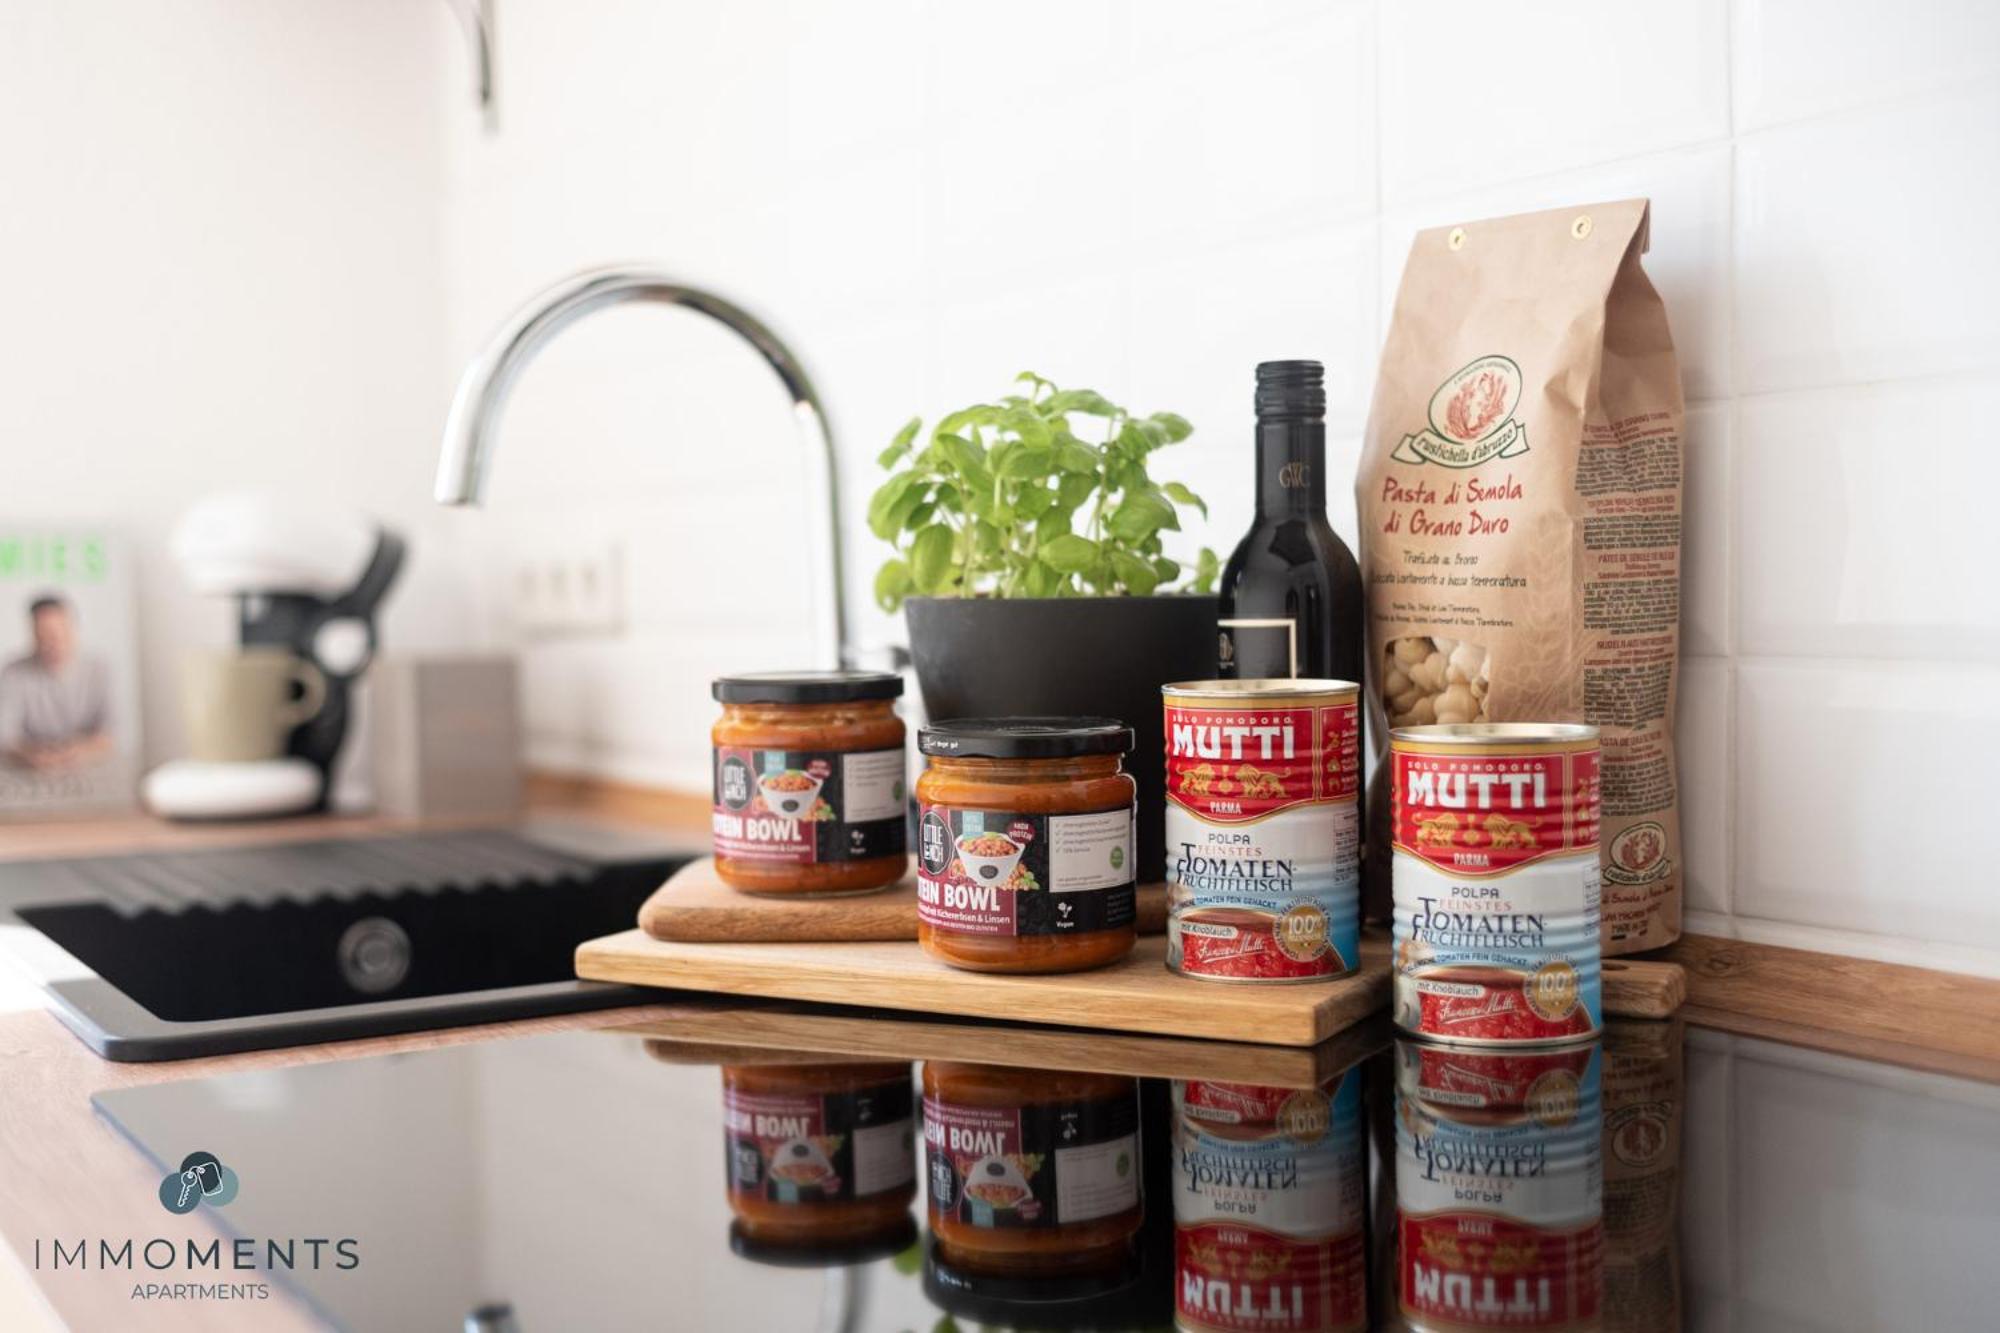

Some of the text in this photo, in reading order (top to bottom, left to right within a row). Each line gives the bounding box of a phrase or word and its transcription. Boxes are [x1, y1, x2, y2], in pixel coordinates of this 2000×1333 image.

[1382, 473, 1523, 504] Pasta di Semola
[1384, 508, 1509, 536] di Grano Duro
[1172, 723, 1295, 760] MUTTI
[1407, 761, 1439, 771] SOLO
[1407, 770, 1546, 809] MUTTI
[1209, 801, 1243, 815] PARMA
[747, 819, 801, 842] BOWL
[1208, 833, 1250, 846] POLPA
[1197, 845, 1263, 857] FEINSTES
[1454, 853, 1490, 867] PARMA
[943, 882, 1000, 911] BOWL
[1452, 887, 1499, 899] POLPA
[1440, 899, 1512, 912] FEINSTES
[985, 914, 1011, 924] Linsen
[1432, 983, 1479, 996] Knoblauch
